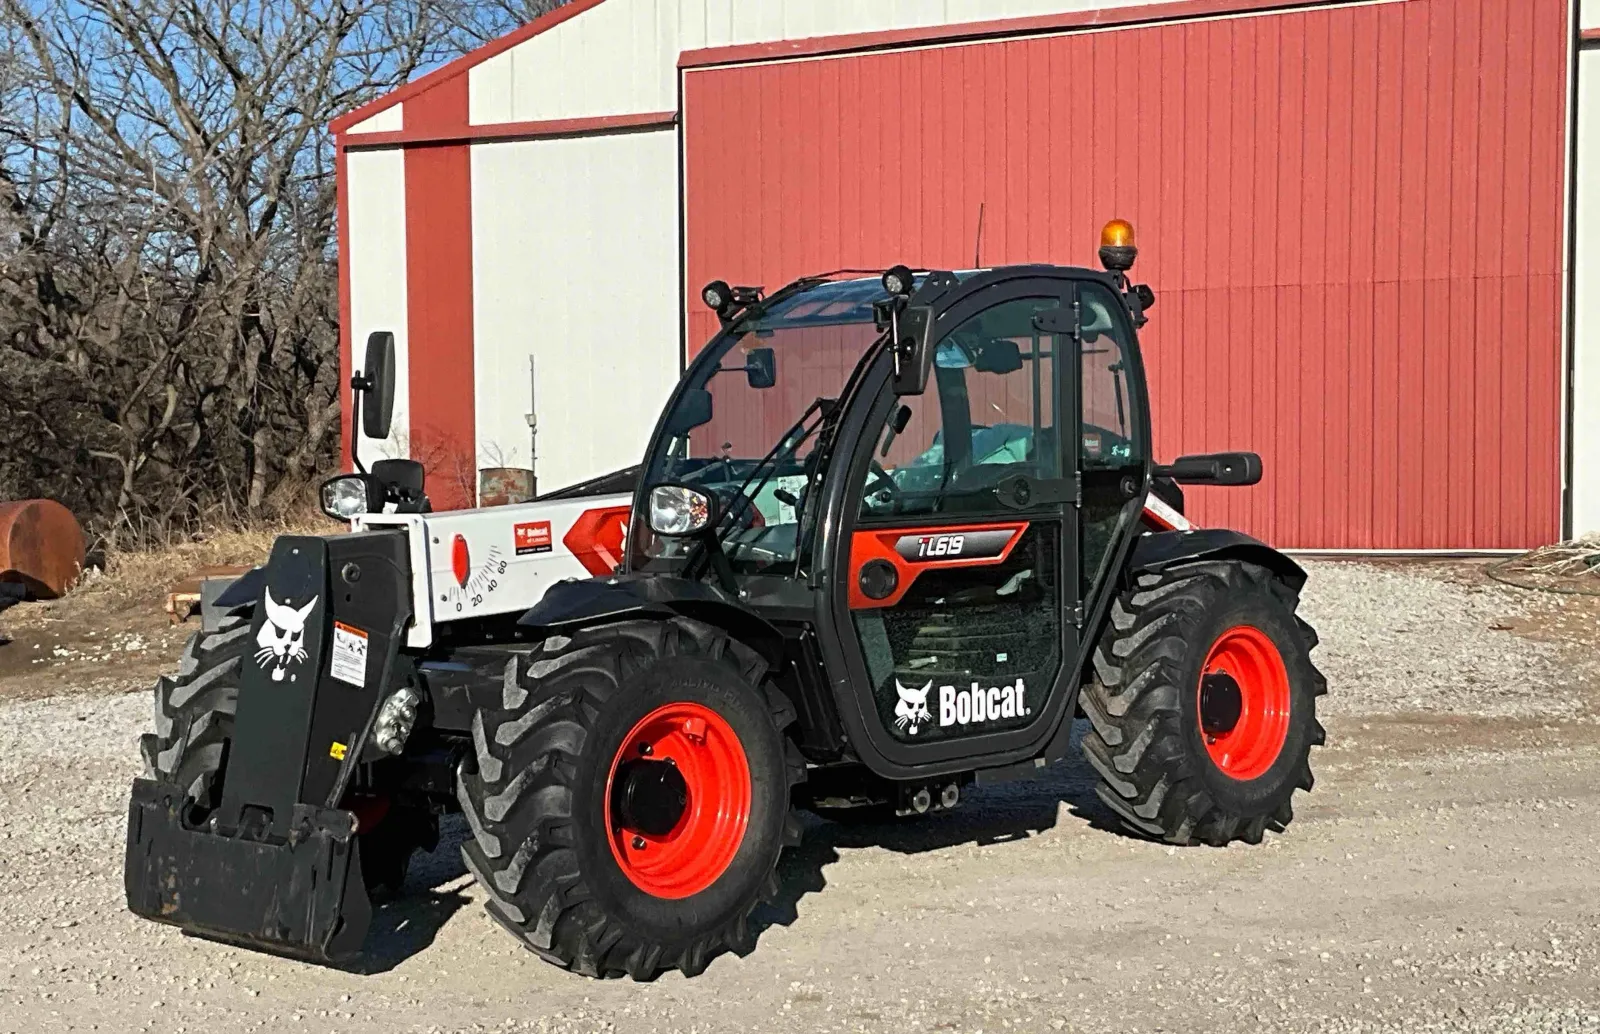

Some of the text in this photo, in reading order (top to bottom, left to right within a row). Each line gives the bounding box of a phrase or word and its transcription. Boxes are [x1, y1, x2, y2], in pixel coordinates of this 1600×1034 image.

[918, 536, 964, 557] TL619
[497, 560, 507, 574] 60
[487, 579, 498, 592] 40
[456, 602, 462, 612] 0
[471, 593, 483, 607] 20
[939, 678, 1025, 726] Bobcat
